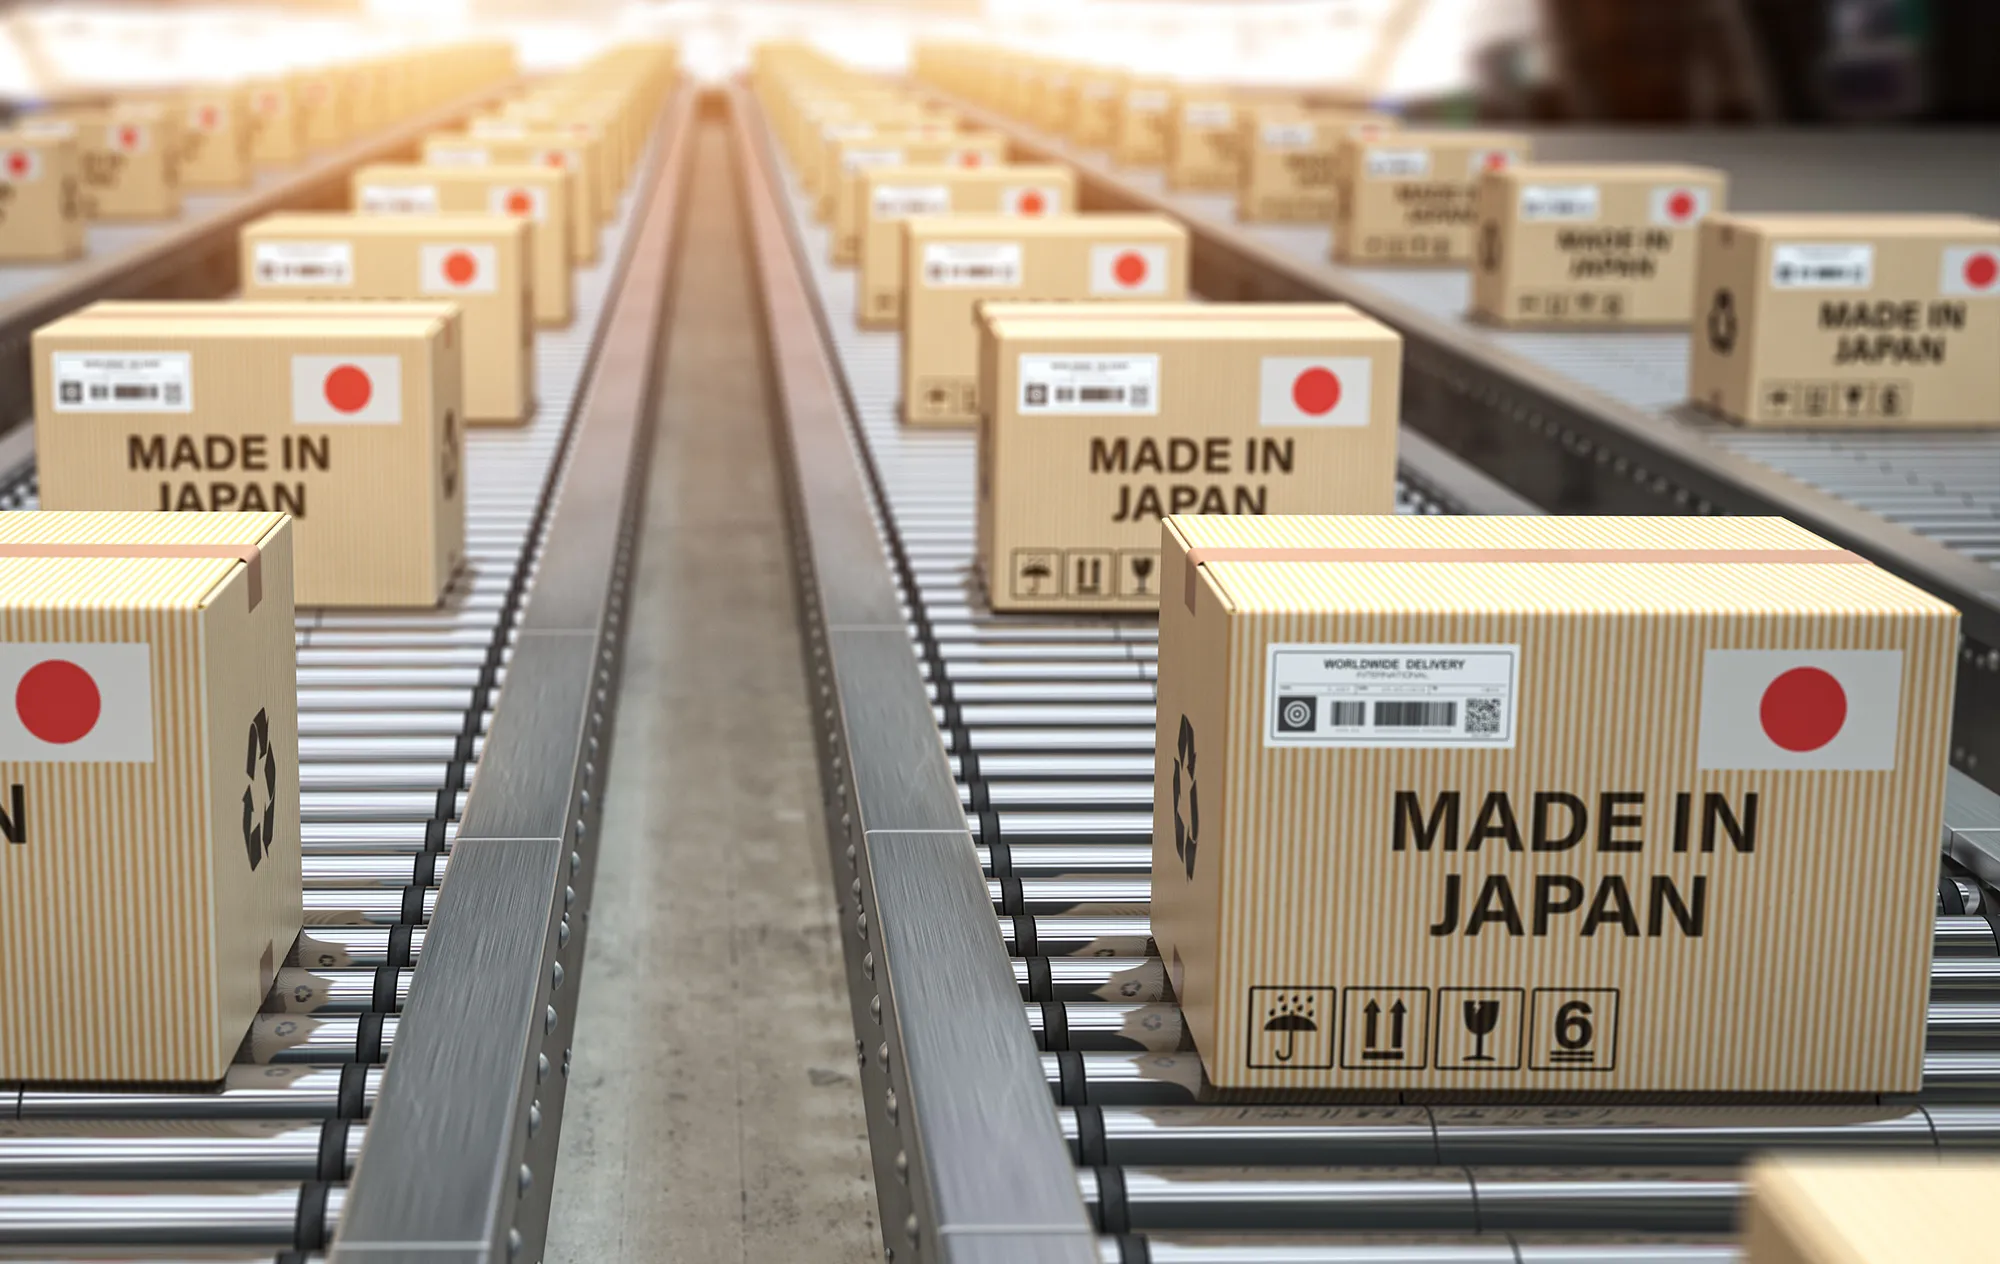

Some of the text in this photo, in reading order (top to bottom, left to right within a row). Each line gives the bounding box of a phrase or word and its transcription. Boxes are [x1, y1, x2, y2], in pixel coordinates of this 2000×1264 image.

[1819, 301, 1966, 331] MADE IN
[1835, 335, 1946, 365] JAPAN
[128, 435, 330, 471] MADE IN
[1089, 437, 1295, 474] MADE IN
[157, 482, 306, 518] JAPAN
[1112, 485, 1267, 523] JAPAN
[1323, 658, 1466, 670] WORLDWIDE DELIVERY
[1392, 790, 1758, 853] MADE IN
[1430, 874, 1707, 938] JAPAN
[1554, 1000, 1594, 1050] 6
